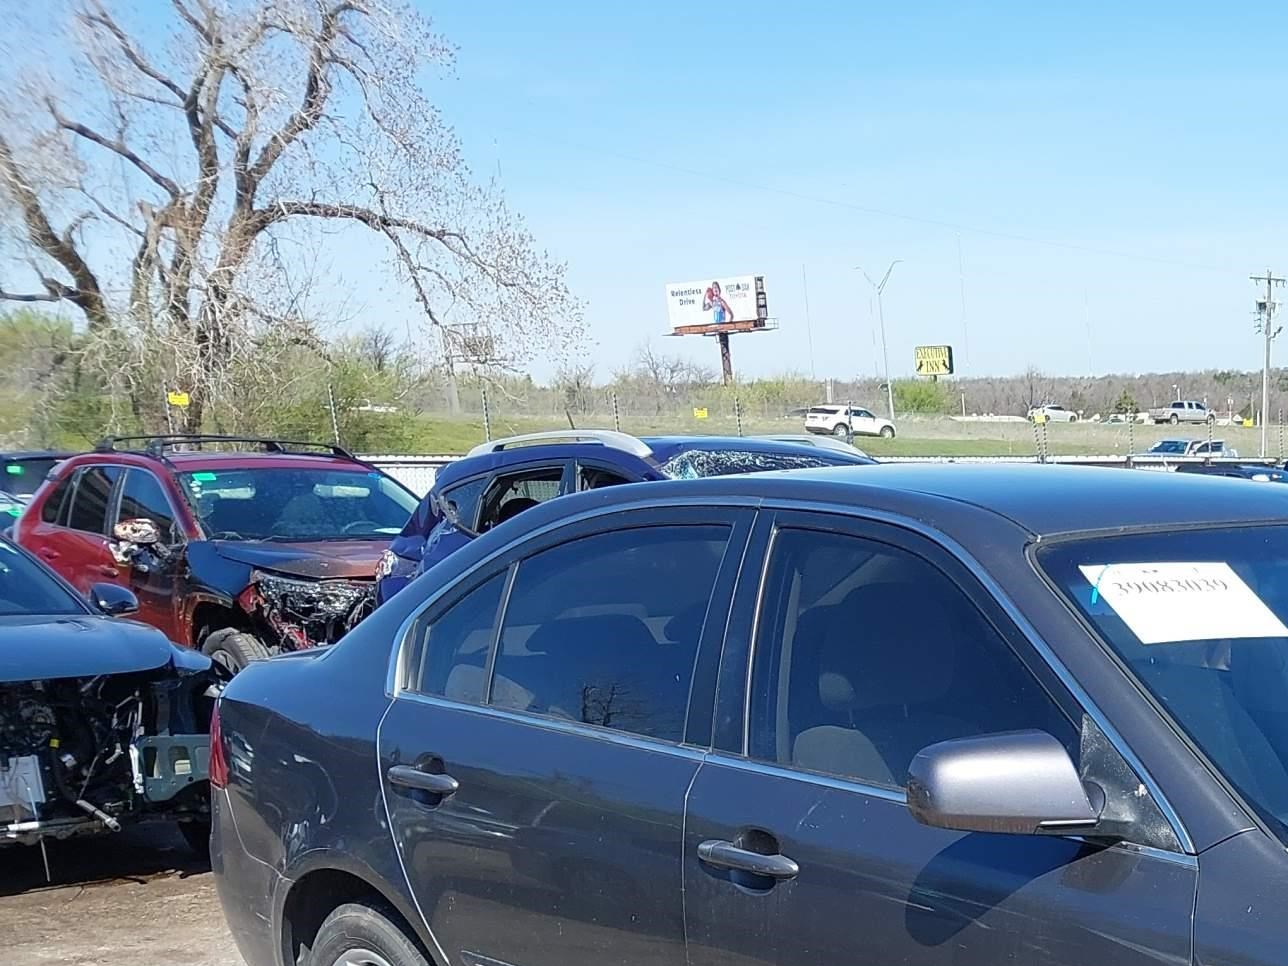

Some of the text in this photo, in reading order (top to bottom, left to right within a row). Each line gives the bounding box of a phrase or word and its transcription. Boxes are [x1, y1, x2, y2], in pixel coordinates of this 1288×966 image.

[670, 287, 702, 297] Relentless
[679, 298, 695, 306] Drive
[926, 360, 940, 373] INN
[1112, 578, 1228, 596] 39083039
